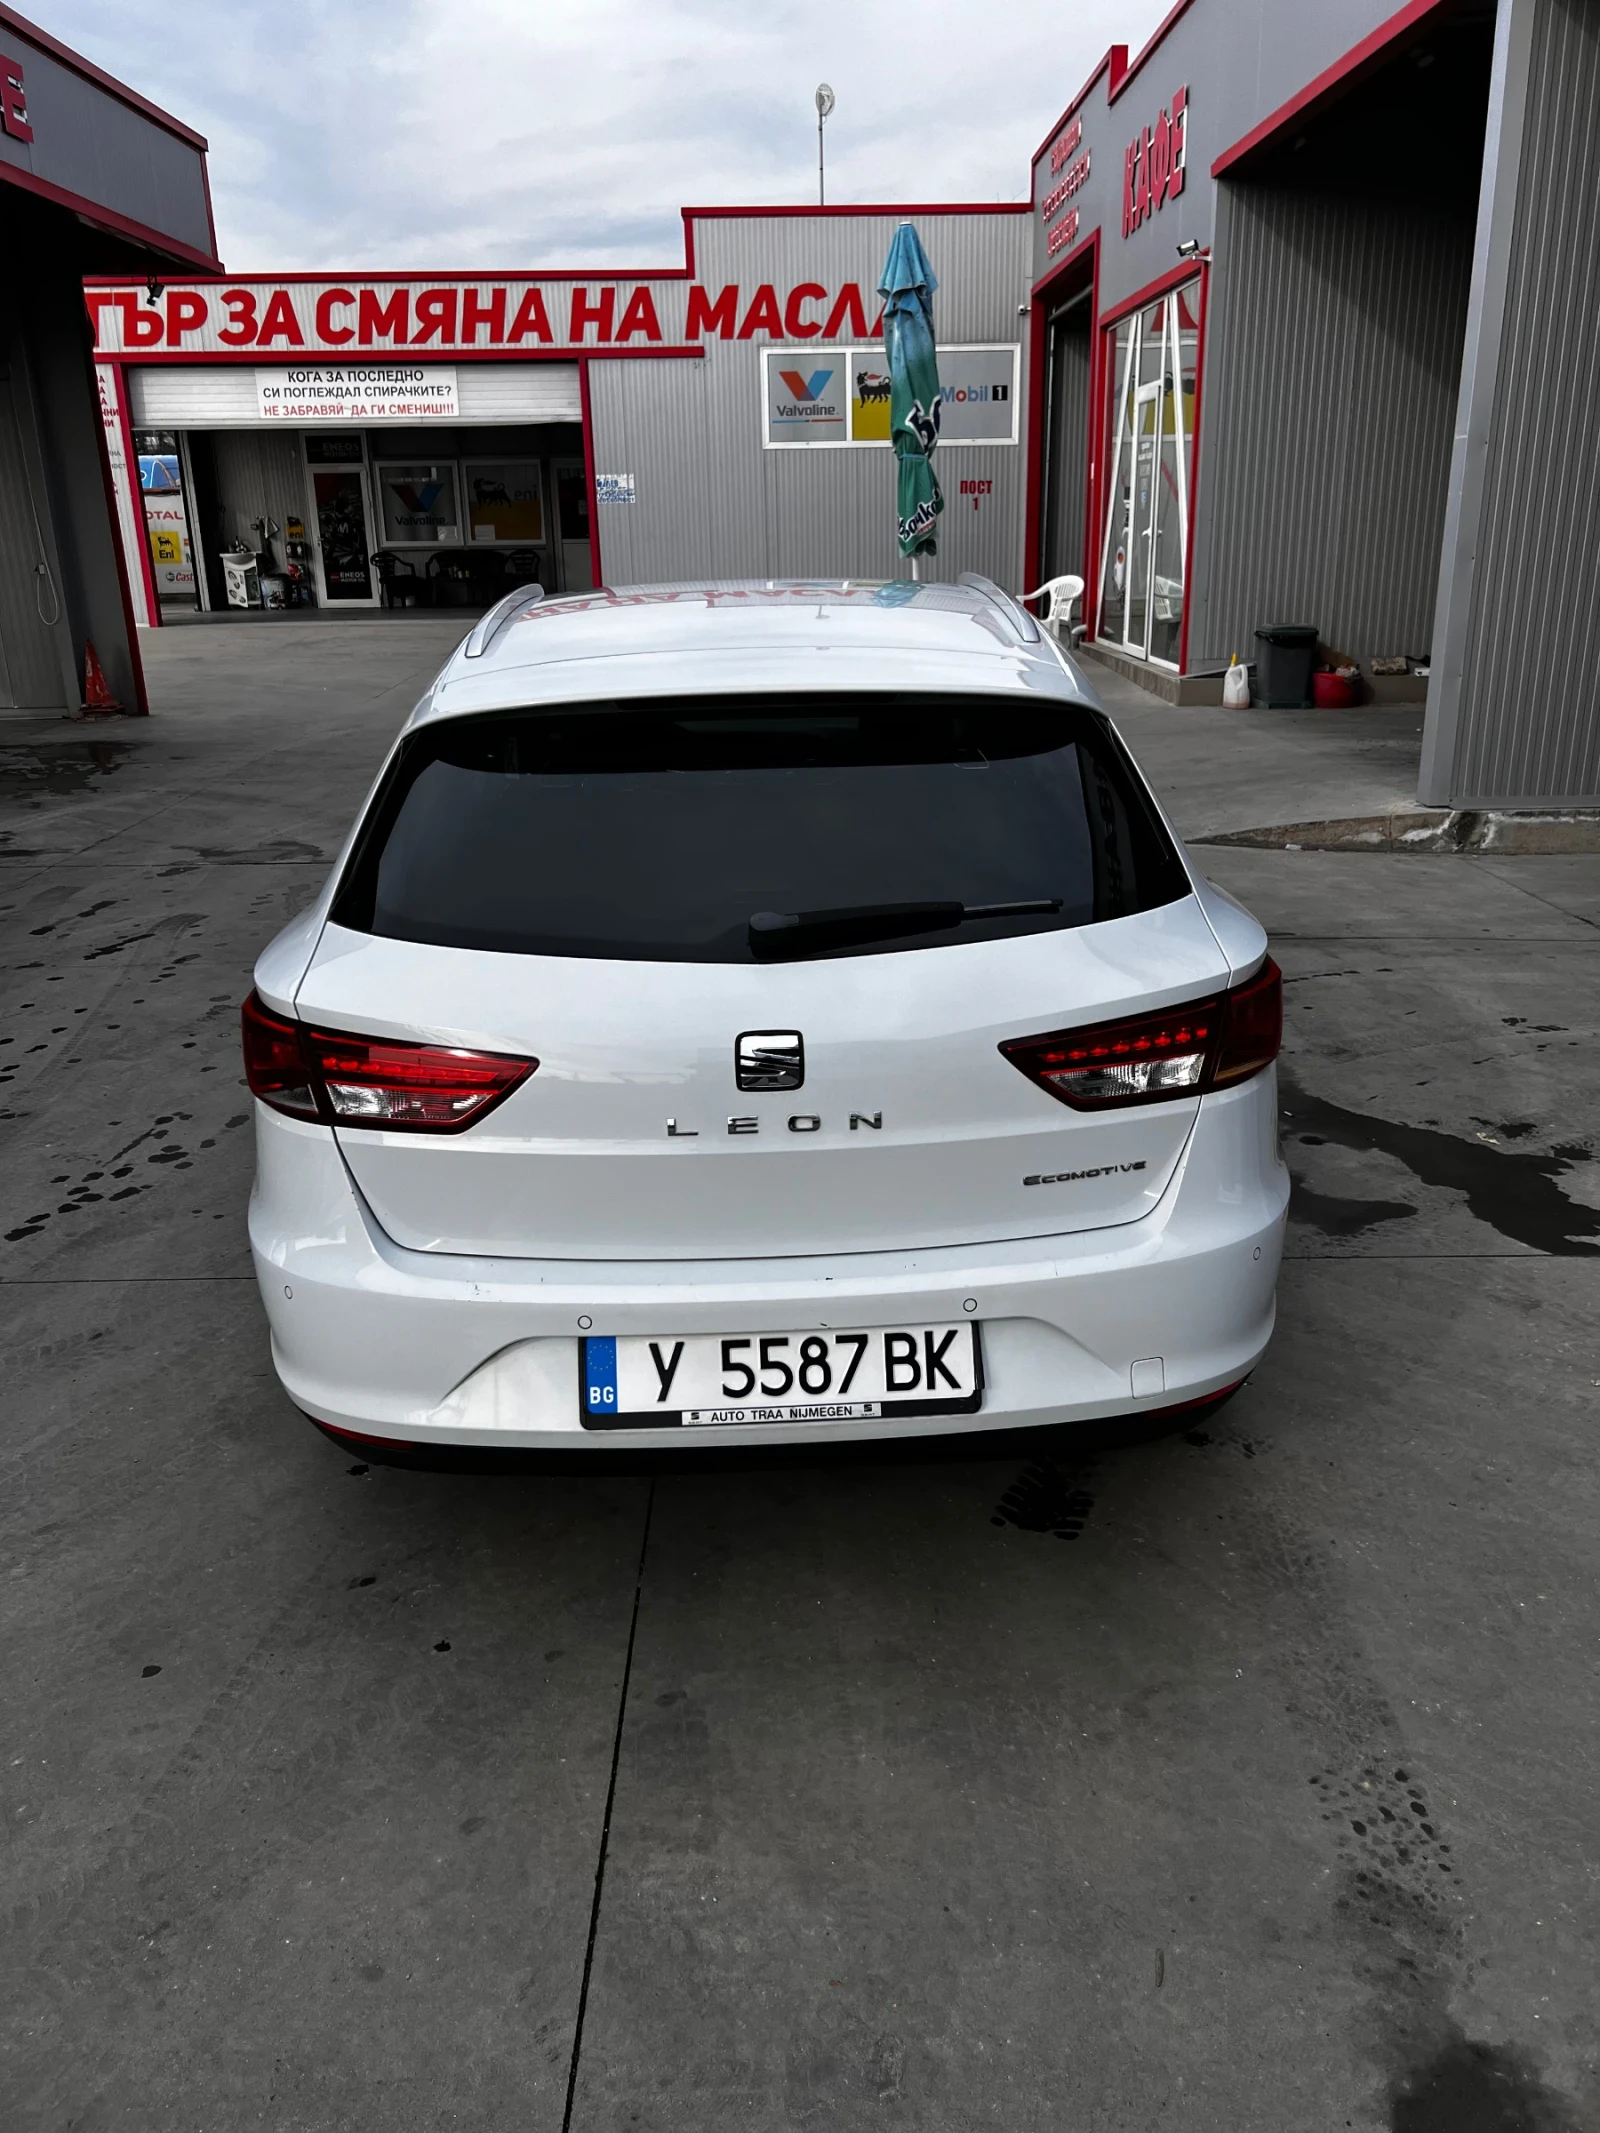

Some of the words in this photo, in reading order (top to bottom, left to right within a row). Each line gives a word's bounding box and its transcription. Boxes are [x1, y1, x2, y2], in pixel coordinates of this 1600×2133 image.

[1121, 83, 1188, 239] КАФЕ
[217, 288, 305, 346] ЗА
[315, 287, 554, 346] СМЯНА
[569, 286, 663, 343] НА
[685, 282, 885, 341] МАСЛ
[287, 371, 322, 383] КОГА
[326, 371, 344, 383] ЗА
[349, 369, 424, 383] ПОСЛЕДНО
[263, 387, 281, 399] СИ
[284, 386, 361, 399] ПОГЛЕЖДАЛ
[366, 385, 452, 398] СПИРАЧКИТЕ?
[941, 385, 988, 403] Mobil
[263, 405, 279, 417] НЕ
[282, 402, 344, 417] ЗАБРАВЯЙ
[350, 404, 368, 417] ДА
[371, 404, 388, 415] ГИ
[390, 403, 455, 416] СМЕНИШ!!!
[776, 404, 836, 417] Valvoline
[959, 480, 993, 494] ПОСТ
[972, 497, 979, 511] 1
[394, 515, 446, 526] Valvoline
[666, 1110, 883, 1136] LEON
[590, 1386, 614, 1404] BG
[721, 1334, 868, 1398] 5587
[884, 1329, 962, 1392] BK
[711, 1411, 745, 1423] AUTO
[750, 1409, 784, 1420] TRAA
[789, 1406, 853, 1418] NIJMEGEN
